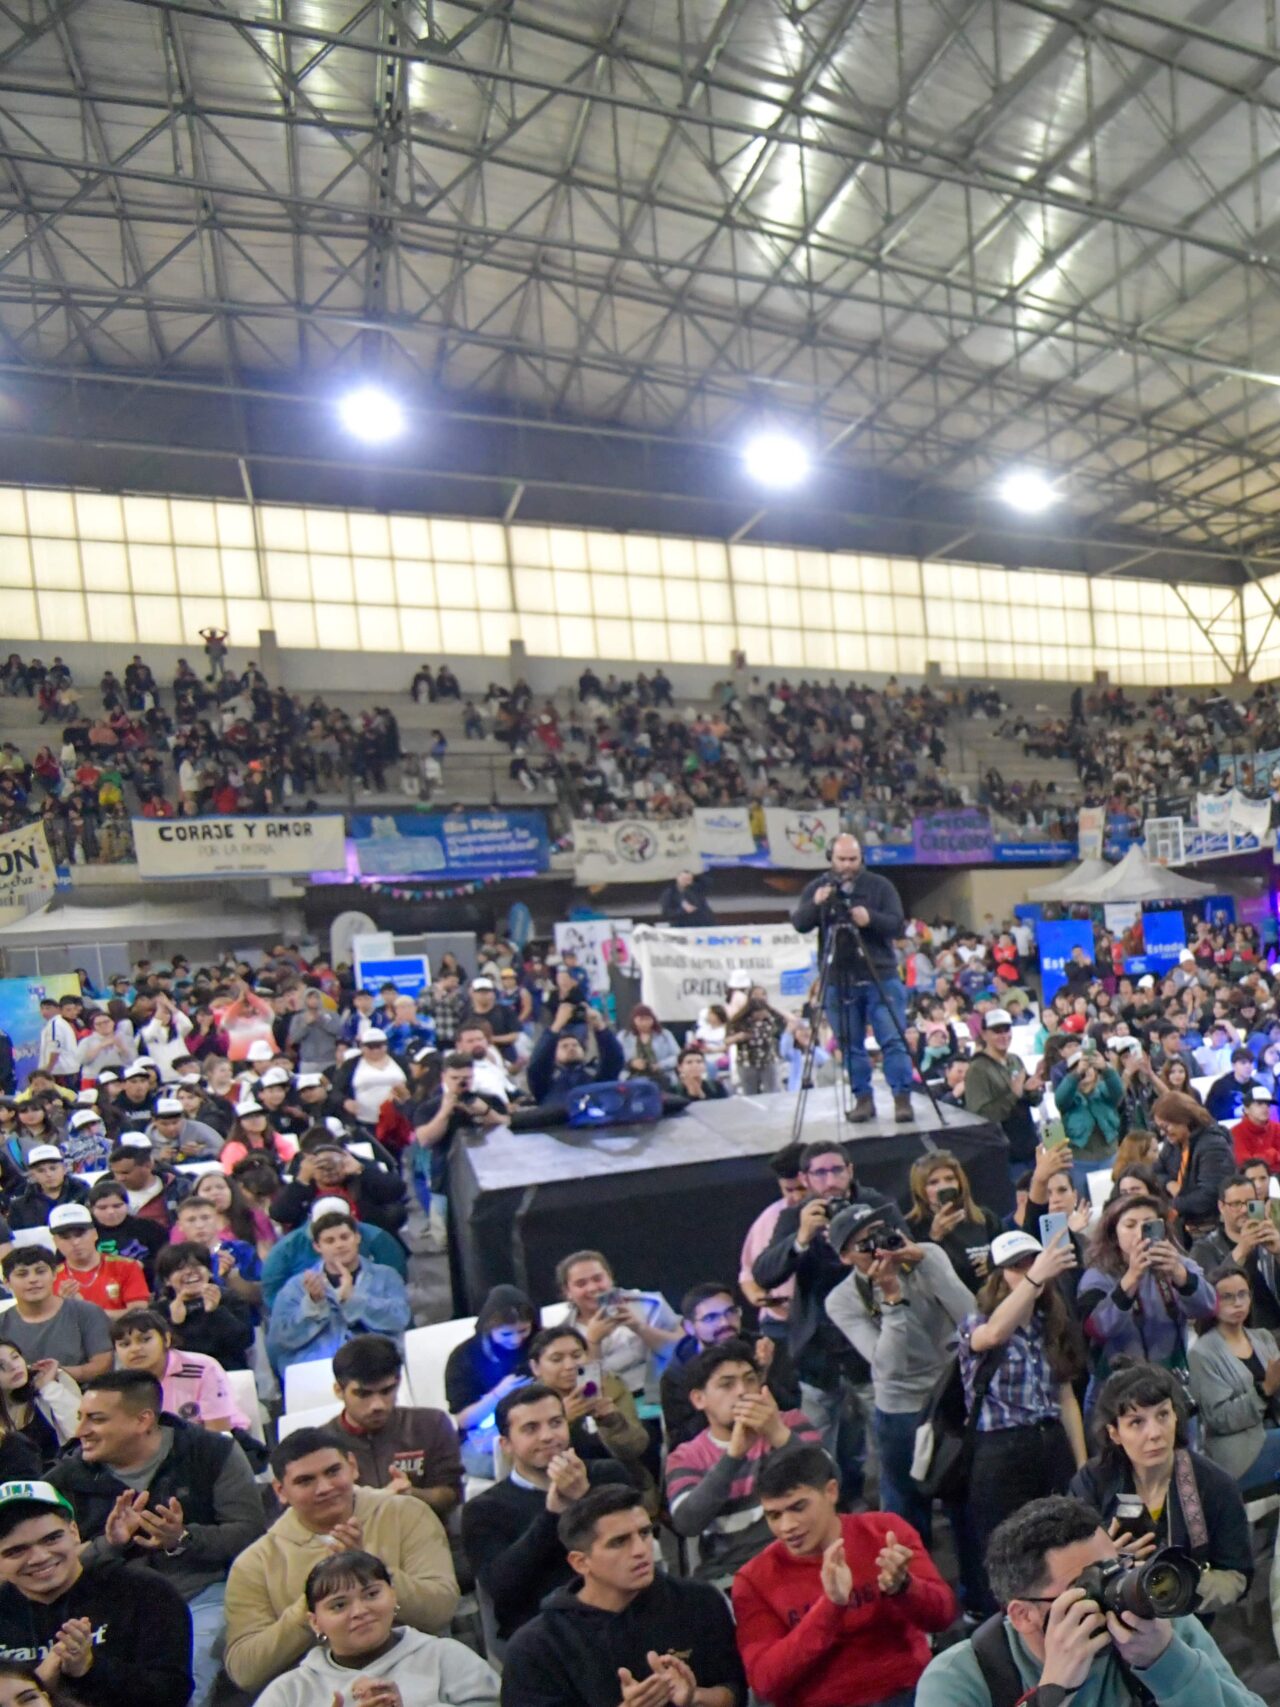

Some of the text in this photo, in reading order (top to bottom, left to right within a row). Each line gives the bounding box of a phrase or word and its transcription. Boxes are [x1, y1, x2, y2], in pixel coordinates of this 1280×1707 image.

[159, 822, 313, 841] CORAJE Y AMOR
